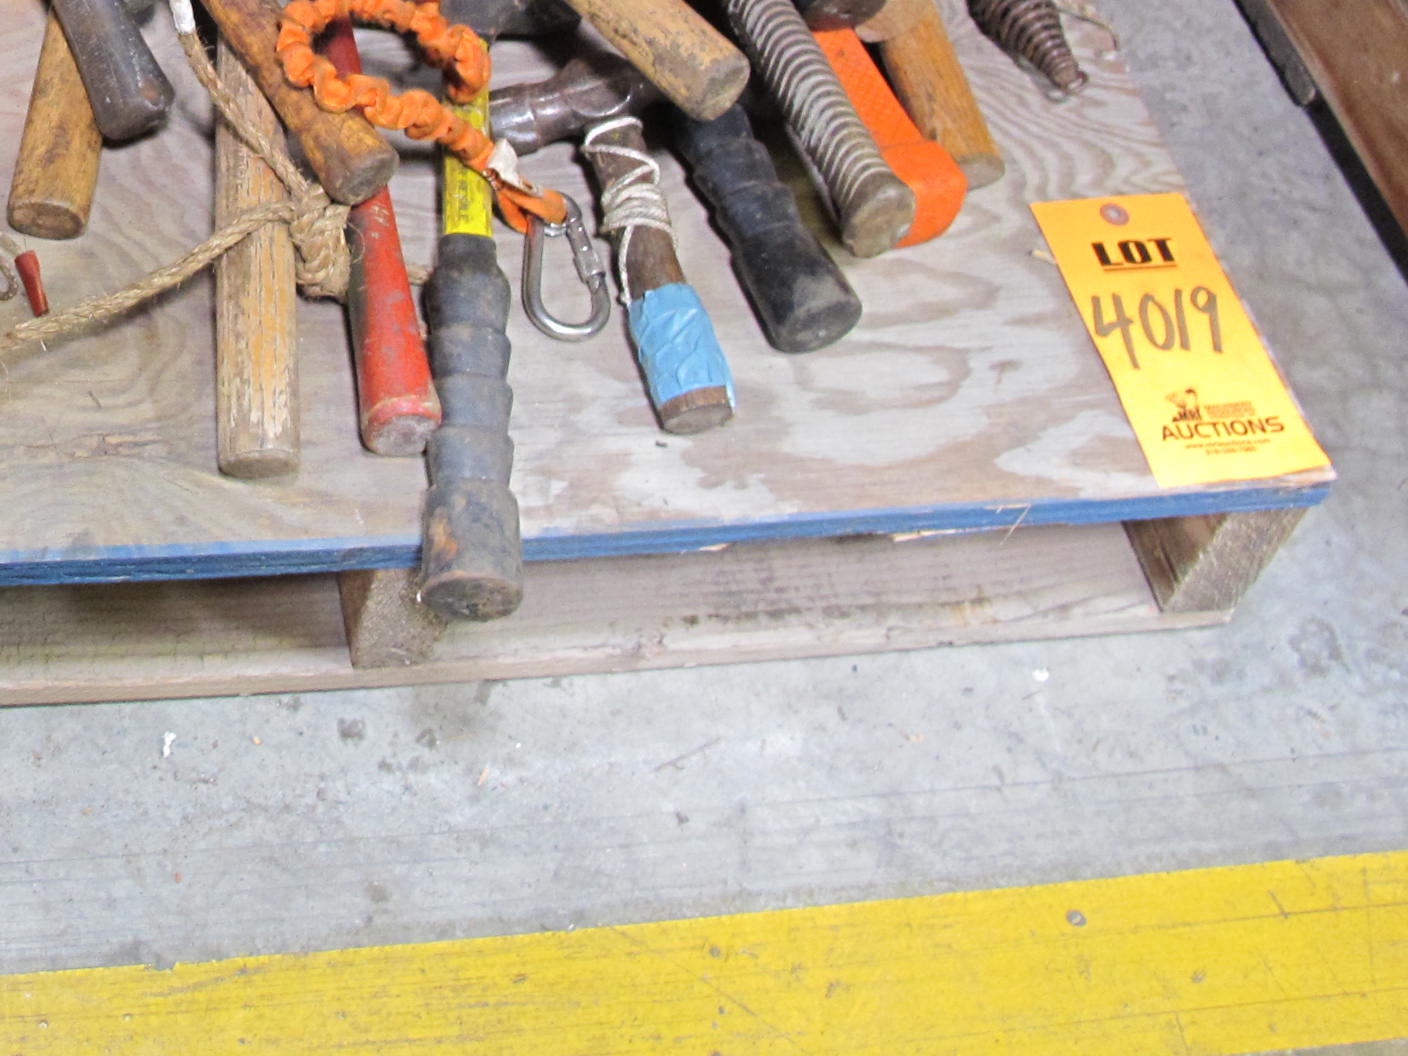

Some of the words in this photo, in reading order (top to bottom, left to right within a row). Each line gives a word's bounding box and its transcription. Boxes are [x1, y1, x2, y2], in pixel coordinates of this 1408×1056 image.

[1091, 237, 1176, 266] LOT
[1091, 285, 1224, 370] 4019
[1161, 416, 1286, 442] AUCTIONS
